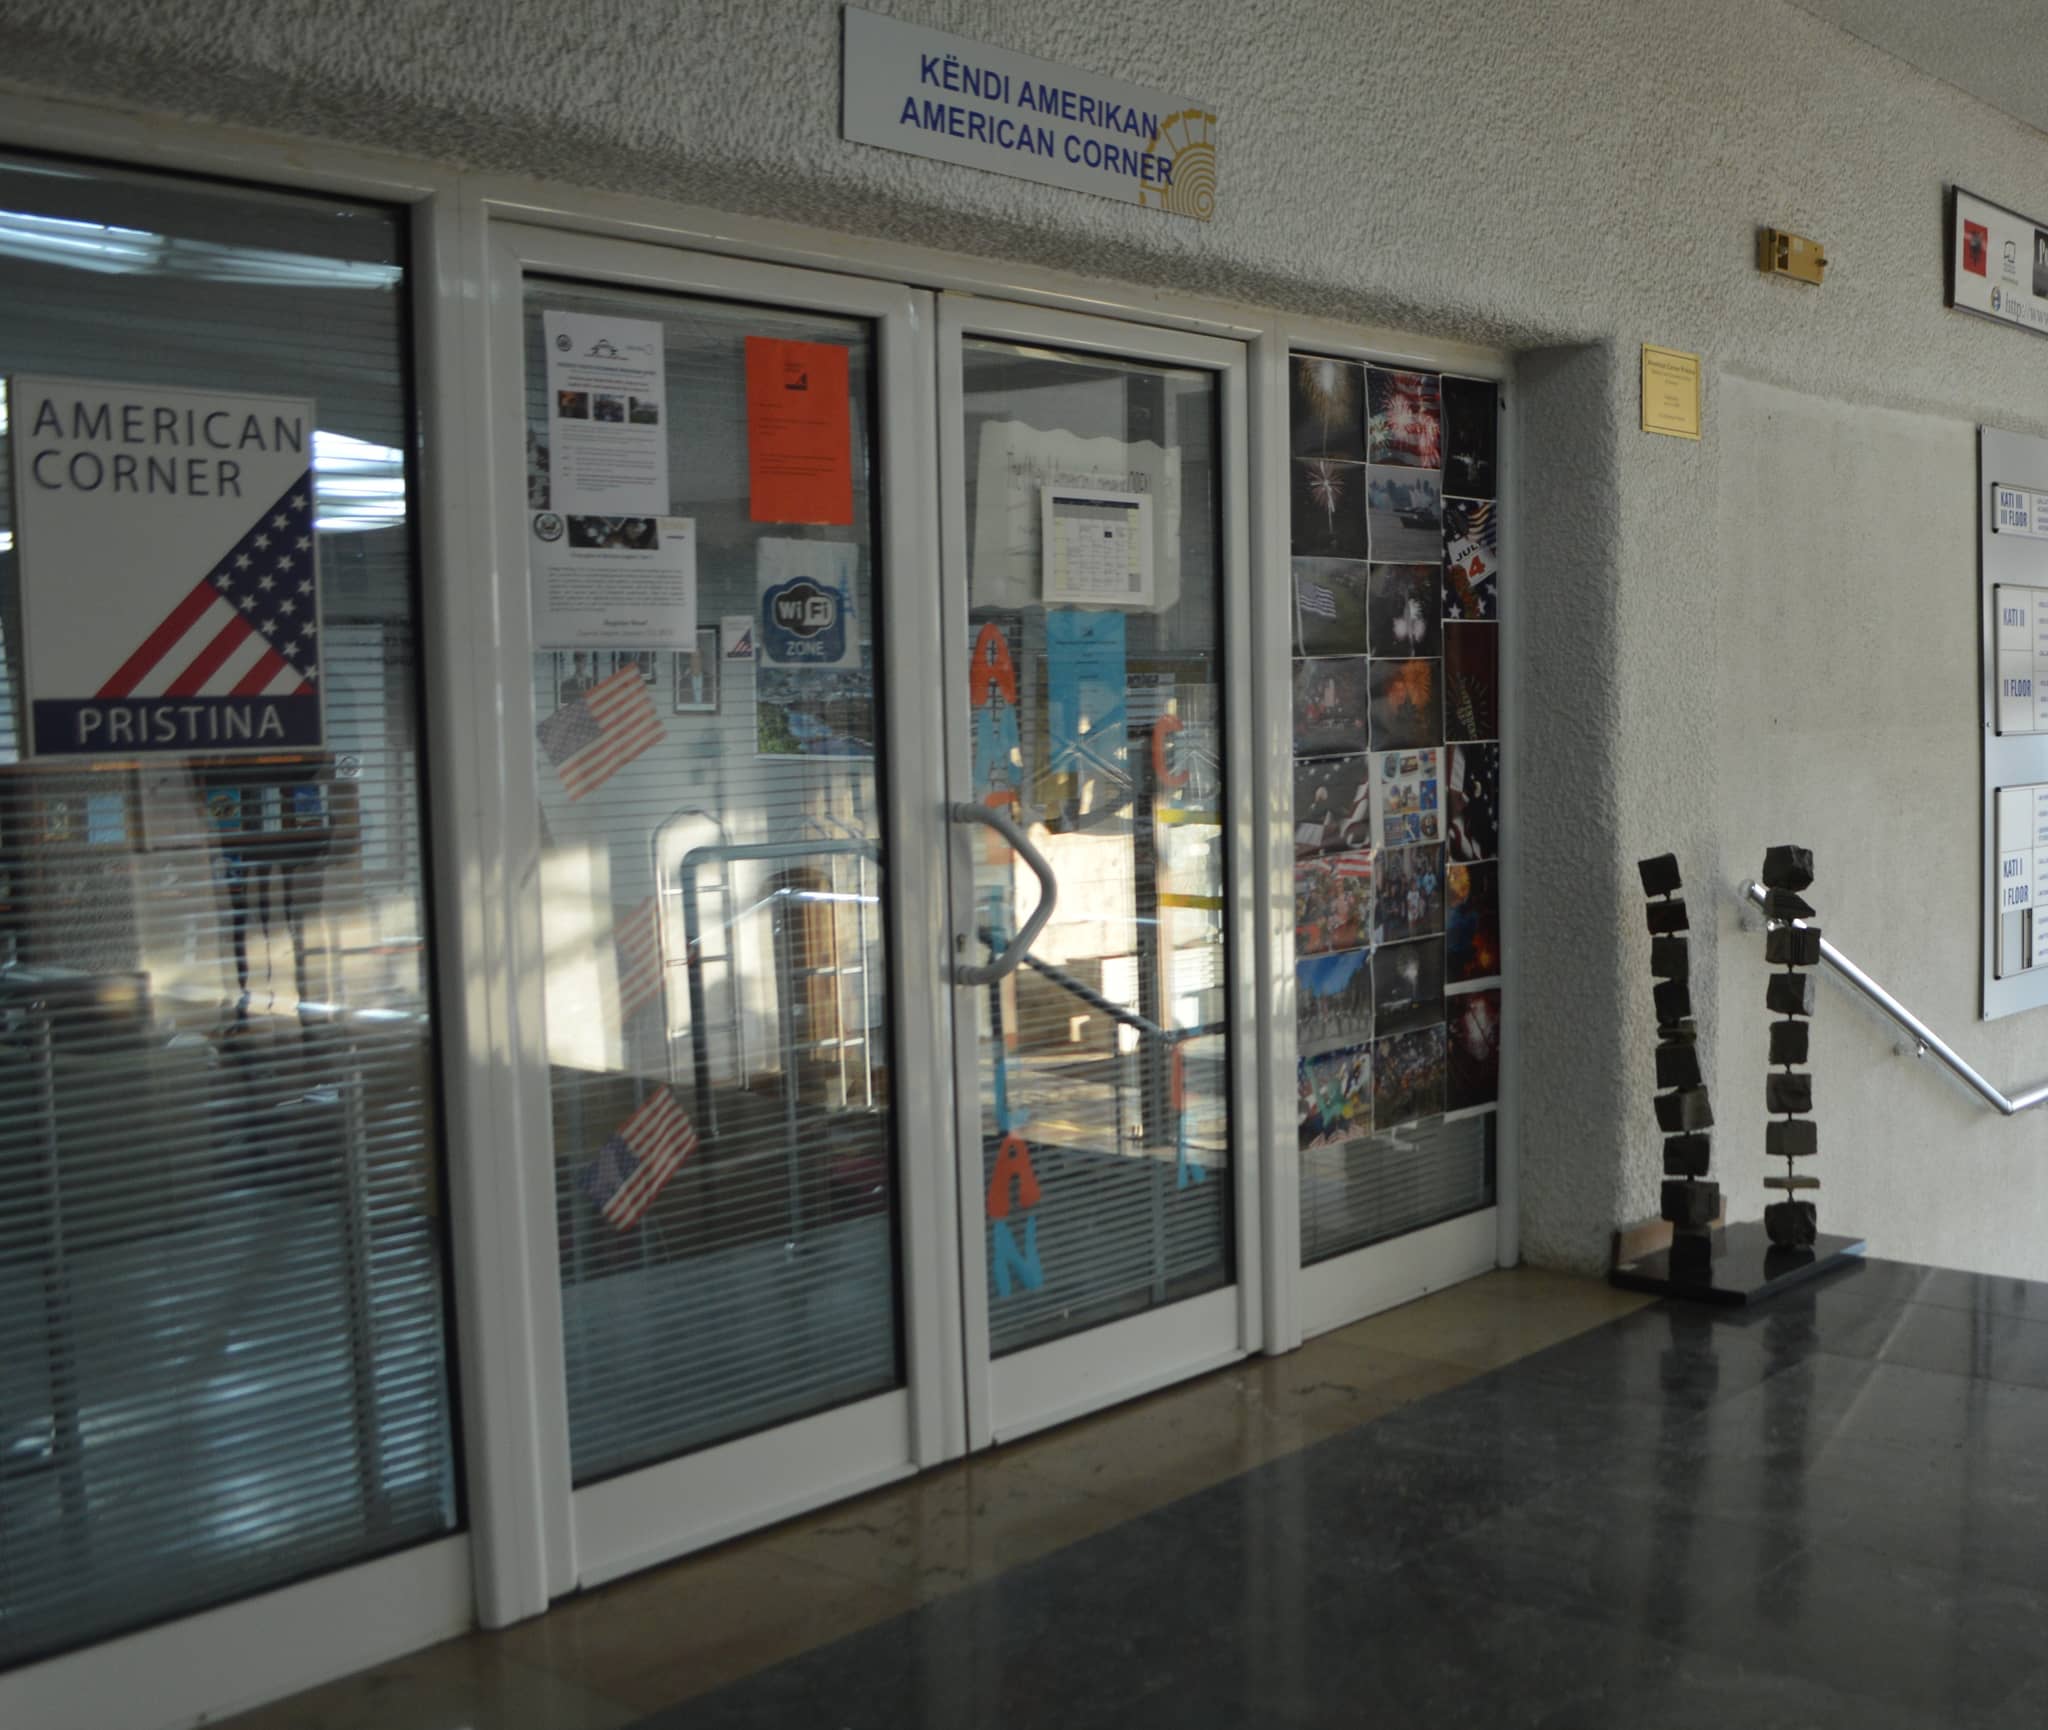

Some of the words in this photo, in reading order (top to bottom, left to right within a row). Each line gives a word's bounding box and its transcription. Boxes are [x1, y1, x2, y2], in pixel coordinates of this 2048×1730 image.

[920, 53, 1010, 104] KËNDI
[1017, 80, 1159, 142] AMERIKAN
[899, 96, 1055, 158] AMERICAN
[1063, 134, 1174, 186] CORNER
[31, 398, 304, 454] AMERICAN
[31, 448, 244, 498] CORNER
[2009, 510, 2028, 528] FLOOR
[1469, 554, 1486, 577] 4
[2003, 607, 2019, 626] KATI
[785, 640, 825, 656] ZONE
[2010, 679, 2032, 697] FLOOR
[77, 705, 285, 744] PRISTINA
[2003, 858, 2019, 878] KATI
[2008, 885, 2029, 906] FLOOR
